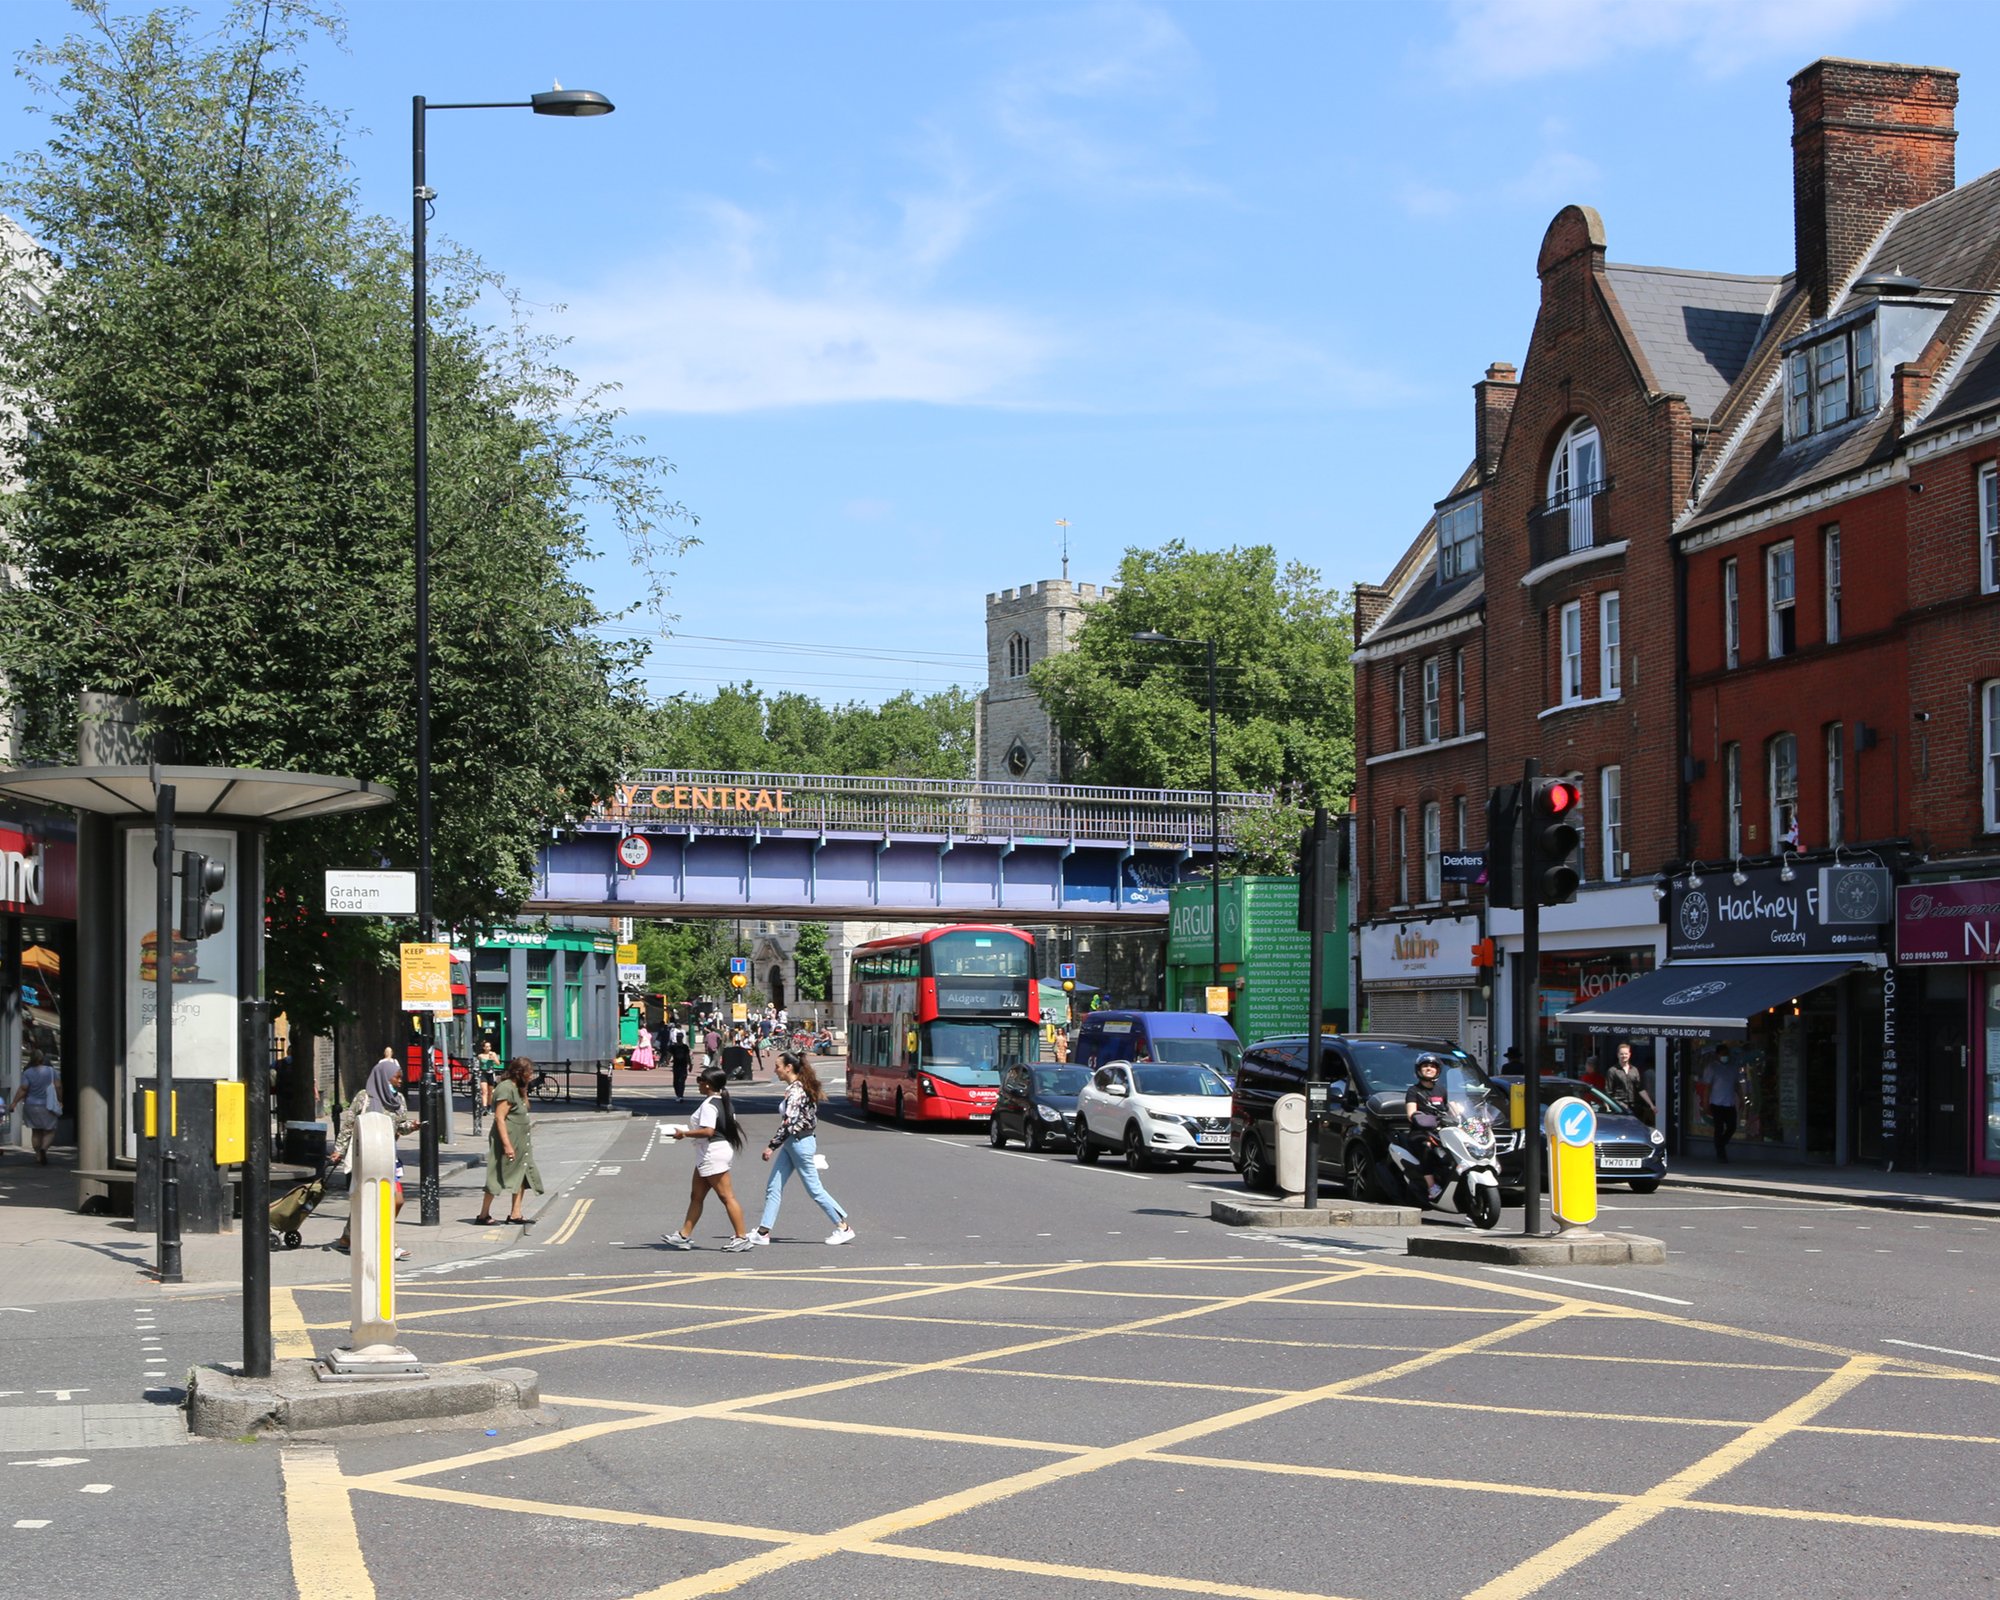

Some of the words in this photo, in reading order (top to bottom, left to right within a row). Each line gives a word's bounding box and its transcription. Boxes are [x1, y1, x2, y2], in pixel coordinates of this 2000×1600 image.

[651, 785, 792, 812] CENTRAL
[1443, 855, 1483, 866] Dexters
[330, 886, 379, 897] Graham
[1839, 874, 1876, 894] HACKNEY
[330, 898, 362, 909] Road
[1683, 894, 1708, 914] HACKNEY
[1718, 890, 1797, 930] Hackney
[1842, 903, 1873, 917] FRESH
[1172, 904, 1214, 936] ARGU
[493, 928, 548, 944] Power
[1770, 930, 1806, 947] Grocery
[1931, 951, 1948, 959] 9503
[623, 972, 641, 980] OPEN
[947, 993, 986, 1004] Aldgate
[1002, 993, 1020, 1007] 242
[1883, 969, 1896, 1044] COFFEE
[1589, 1026, 1610, 1034] ORGANIC
[1613, 1026, 1628, 1034] VEGAN
[1631, 1027, 1648, 1035] GLUTEN
[1684, 1029, 1697, 1037] BODY
